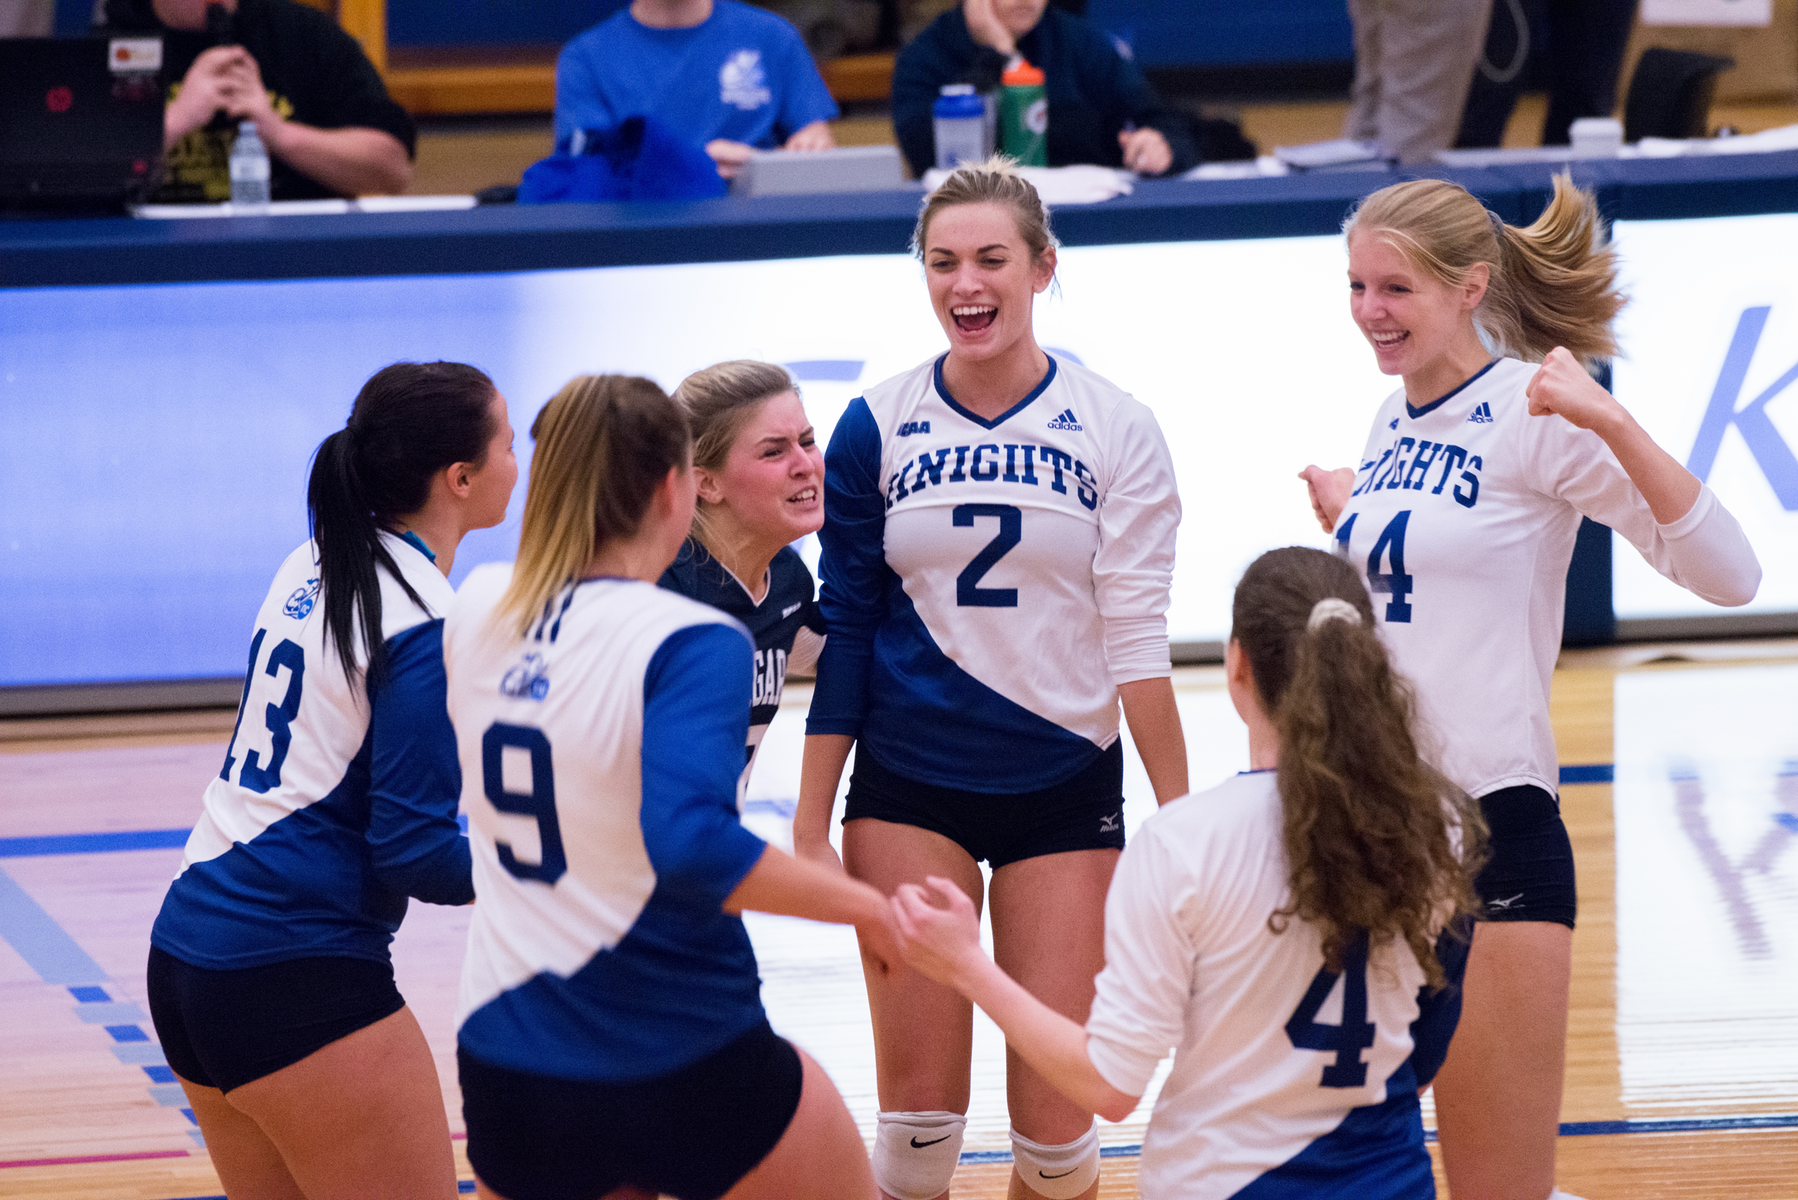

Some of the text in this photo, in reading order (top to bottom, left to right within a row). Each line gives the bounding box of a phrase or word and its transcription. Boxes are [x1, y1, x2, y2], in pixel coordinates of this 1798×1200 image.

[1047, 421, 1083, 432] adidas
[1351, 436, 1483, 508] NIGHTS
[952, 503, 1022, 607] 2
[219, 627, 305, 794] 13
[482, 719, 568, 886] 9
[1284, 923, 1377, 1088] 4
